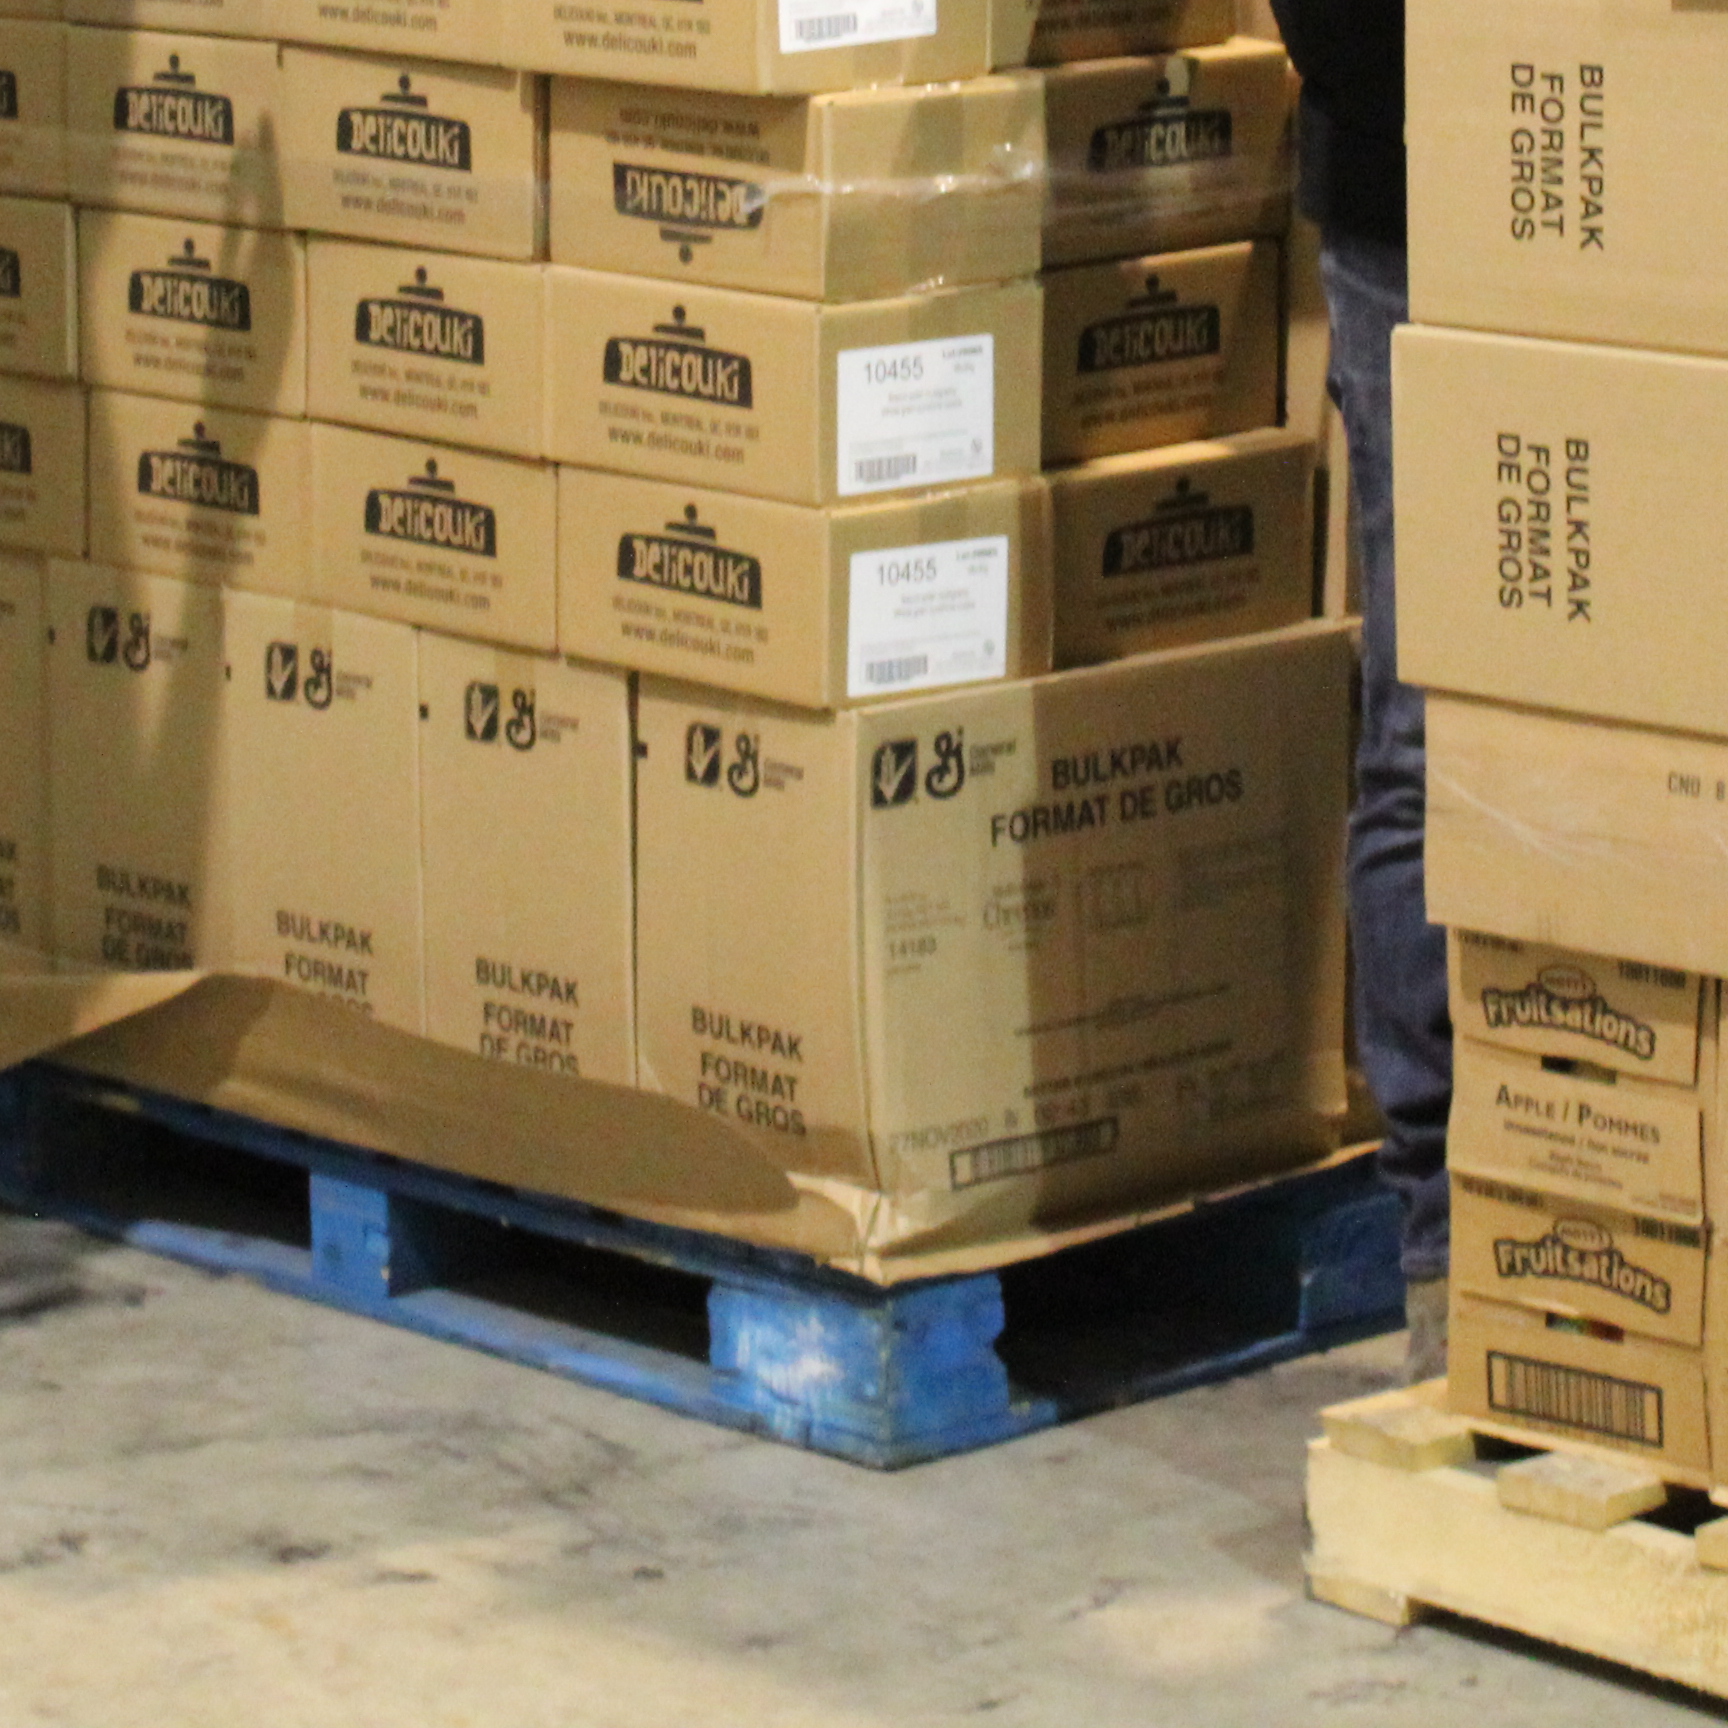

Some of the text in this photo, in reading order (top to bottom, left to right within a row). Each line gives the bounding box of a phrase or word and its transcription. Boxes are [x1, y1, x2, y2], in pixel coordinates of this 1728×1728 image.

[564, 28, 697, 59] www.delicouki.com
[1511, 63, 1535, 241] DE GROS
[1541, 72, 1564, 237] FORMAT
[1579, 64, 1604, 251] BULKPAK
[864, 356, 924, 384] 10455
[1497, 432, 1523, 609] DE GROS
[1527, 443, 1552, 608] FORMAT
[1566, 438, 1591, 623] BULKPAK
[878, 558, 937, 586] 10455
[1052, 737, 1182, 791] BULKPAK
[991, 769, 1245, 847] FORMAT DE GROS
[276, 909, 373, 955] BULKPAK
[285, 952, 370, 995] FORMAT
[476, 957, 579, 1007] BULKPAK
[483, 1001, 574, 1045] FORMAT
[692, 1005, 803, 1062] BULKPAK
[1482, 987, 1655, 1060] Fruitsations
[479, 1032, 579, 1073] DE GROS
[701, 1051, 798, 1102] FORMAT
[698, 1082, 807, 1137] DE GROS
[1494, 1238, 1670, 1314] Fruitsations
